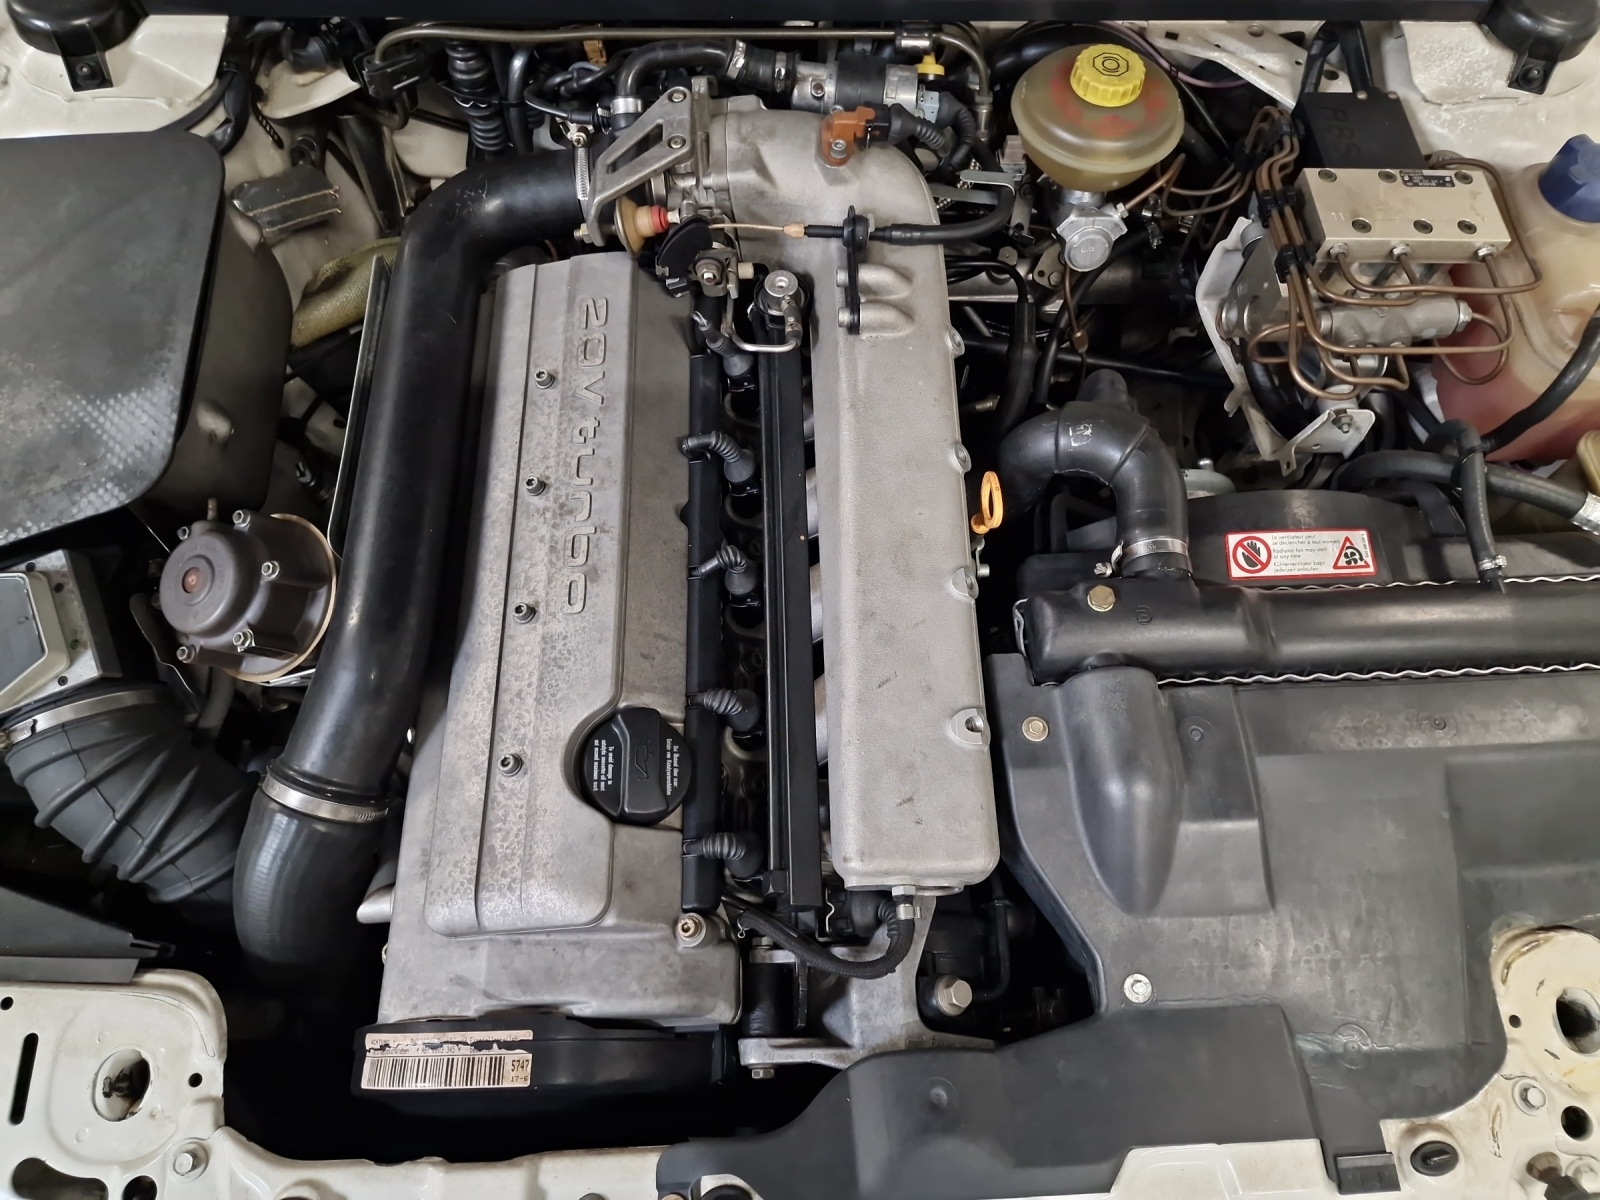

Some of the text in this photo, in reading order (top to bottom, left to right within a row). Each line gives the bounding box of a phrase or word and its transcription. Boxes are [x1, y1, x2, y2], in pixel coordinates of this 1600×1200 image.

[563, 297, 608, 615] 20V turbo
[606, 763, 614, 779] damage
[511, 1059, 530, 1072] 5747
